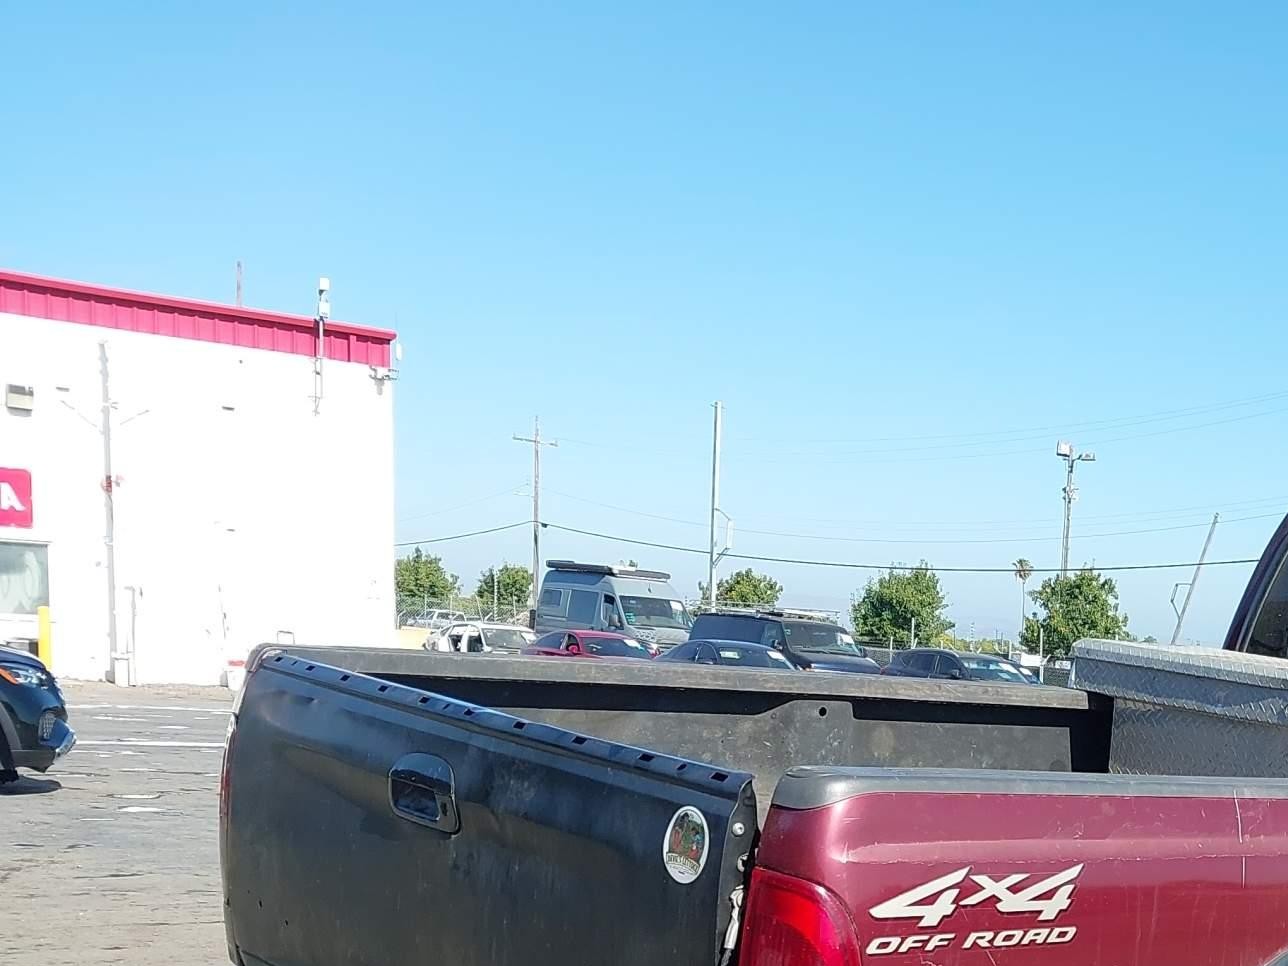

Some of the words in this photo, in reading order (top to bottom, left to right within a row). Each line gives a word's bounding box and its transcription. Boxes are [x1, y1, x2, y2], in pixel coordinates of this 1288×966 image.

[868, 862, 1085, 928] 4x4
[866, 933, 956, 956] OFF
[961, 926, 1078, 950] ROAD
